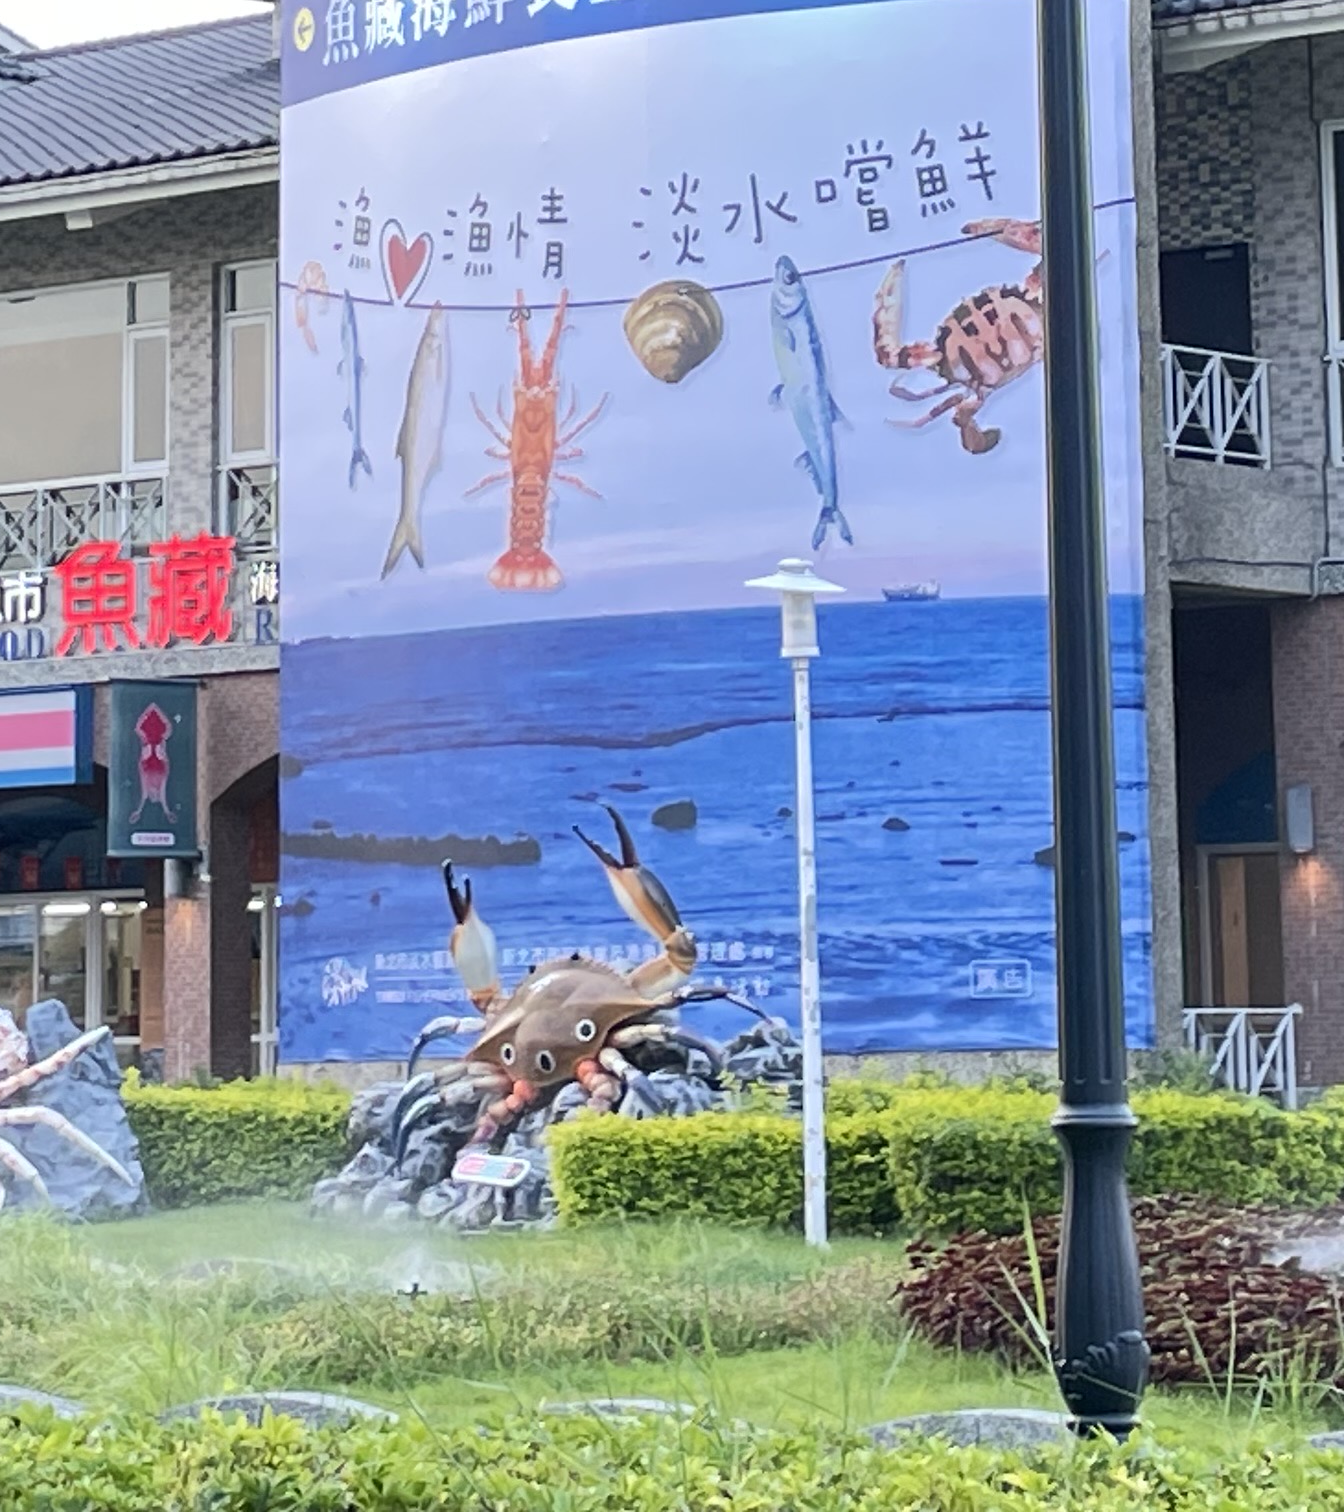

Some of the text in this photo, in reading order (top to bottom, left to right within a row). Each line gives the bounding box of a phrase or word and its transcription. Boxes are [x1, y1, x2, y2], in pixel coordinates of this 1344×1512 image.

[632, 121, 999, 267] 淡水嚐鮮
[54, 530, 237, 657] 魚藏
